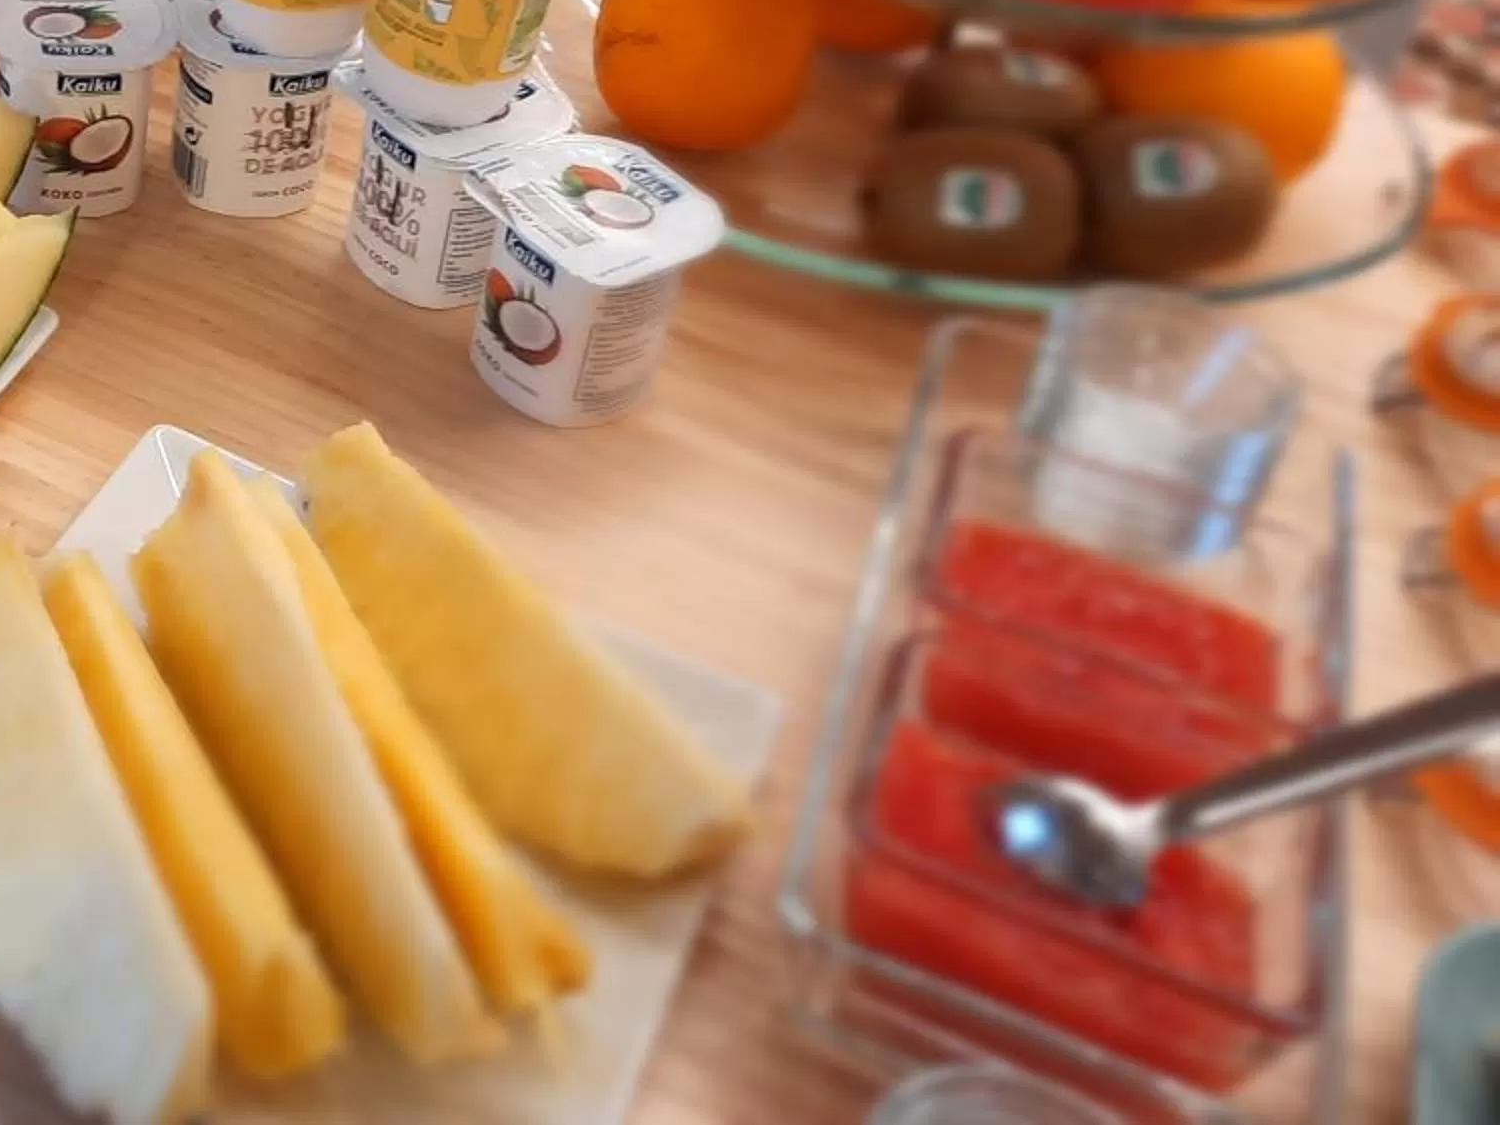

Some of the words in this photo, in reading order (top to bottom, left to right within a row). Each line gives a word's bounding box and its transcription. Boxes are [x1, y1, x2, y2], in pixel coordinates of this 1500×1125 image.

[60, 77, 119, 93] Kaiku
[273, 77, 327, 92] Kaiku
[373, 123, 413, 167] Kaiku
[505, 231, 552, 282] Kaiku
